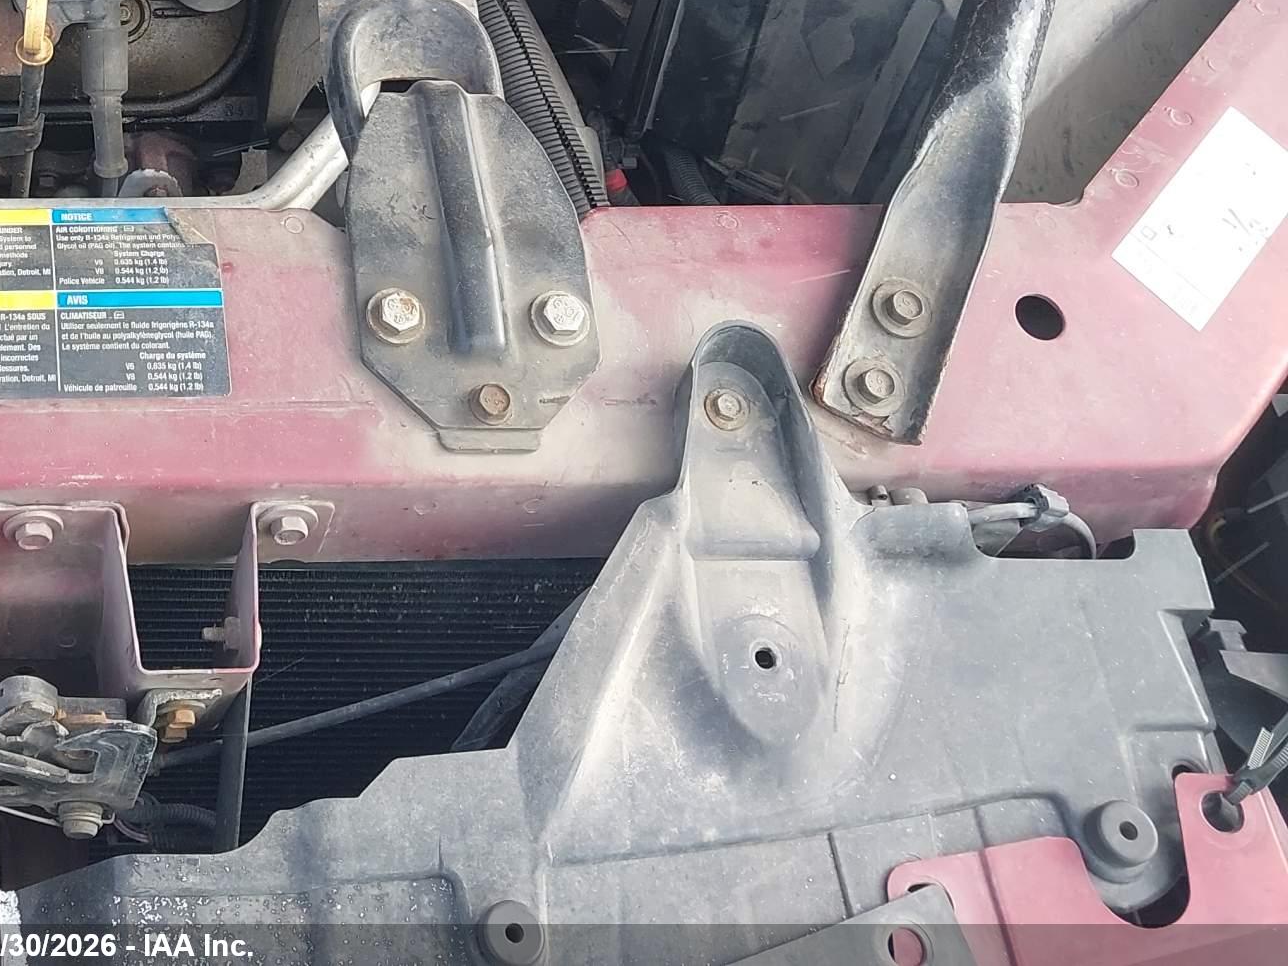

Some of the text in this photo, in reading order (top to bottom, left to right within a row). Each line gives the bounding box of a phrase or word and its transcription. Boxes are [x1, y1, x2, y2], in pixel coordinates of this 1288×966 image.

[61, 213, 93, 221] NOTICE
[113, 249, 165, 258] System Charge
[59, 277, 80, 285] Police
[66, 295, 88, 305] AVIS
[26, 312, 46, 321] SOUS
[60, 311, 107, 320] CLIMATISEUR
[86, 321, 122, 330] seulement
[27, 343, 41, 351] Des
[71, 342, 101, 351] système
[101, 342, 130, 350] contient
[139, 351, 165, 360] Charge
[176, 350, 207, 360] système
[167, 361, 177, 371] kg
[168, 372, 178, 381] kg
[63, 383, 93, 392] Véhicule
[169, 383, 178, 392] kg
